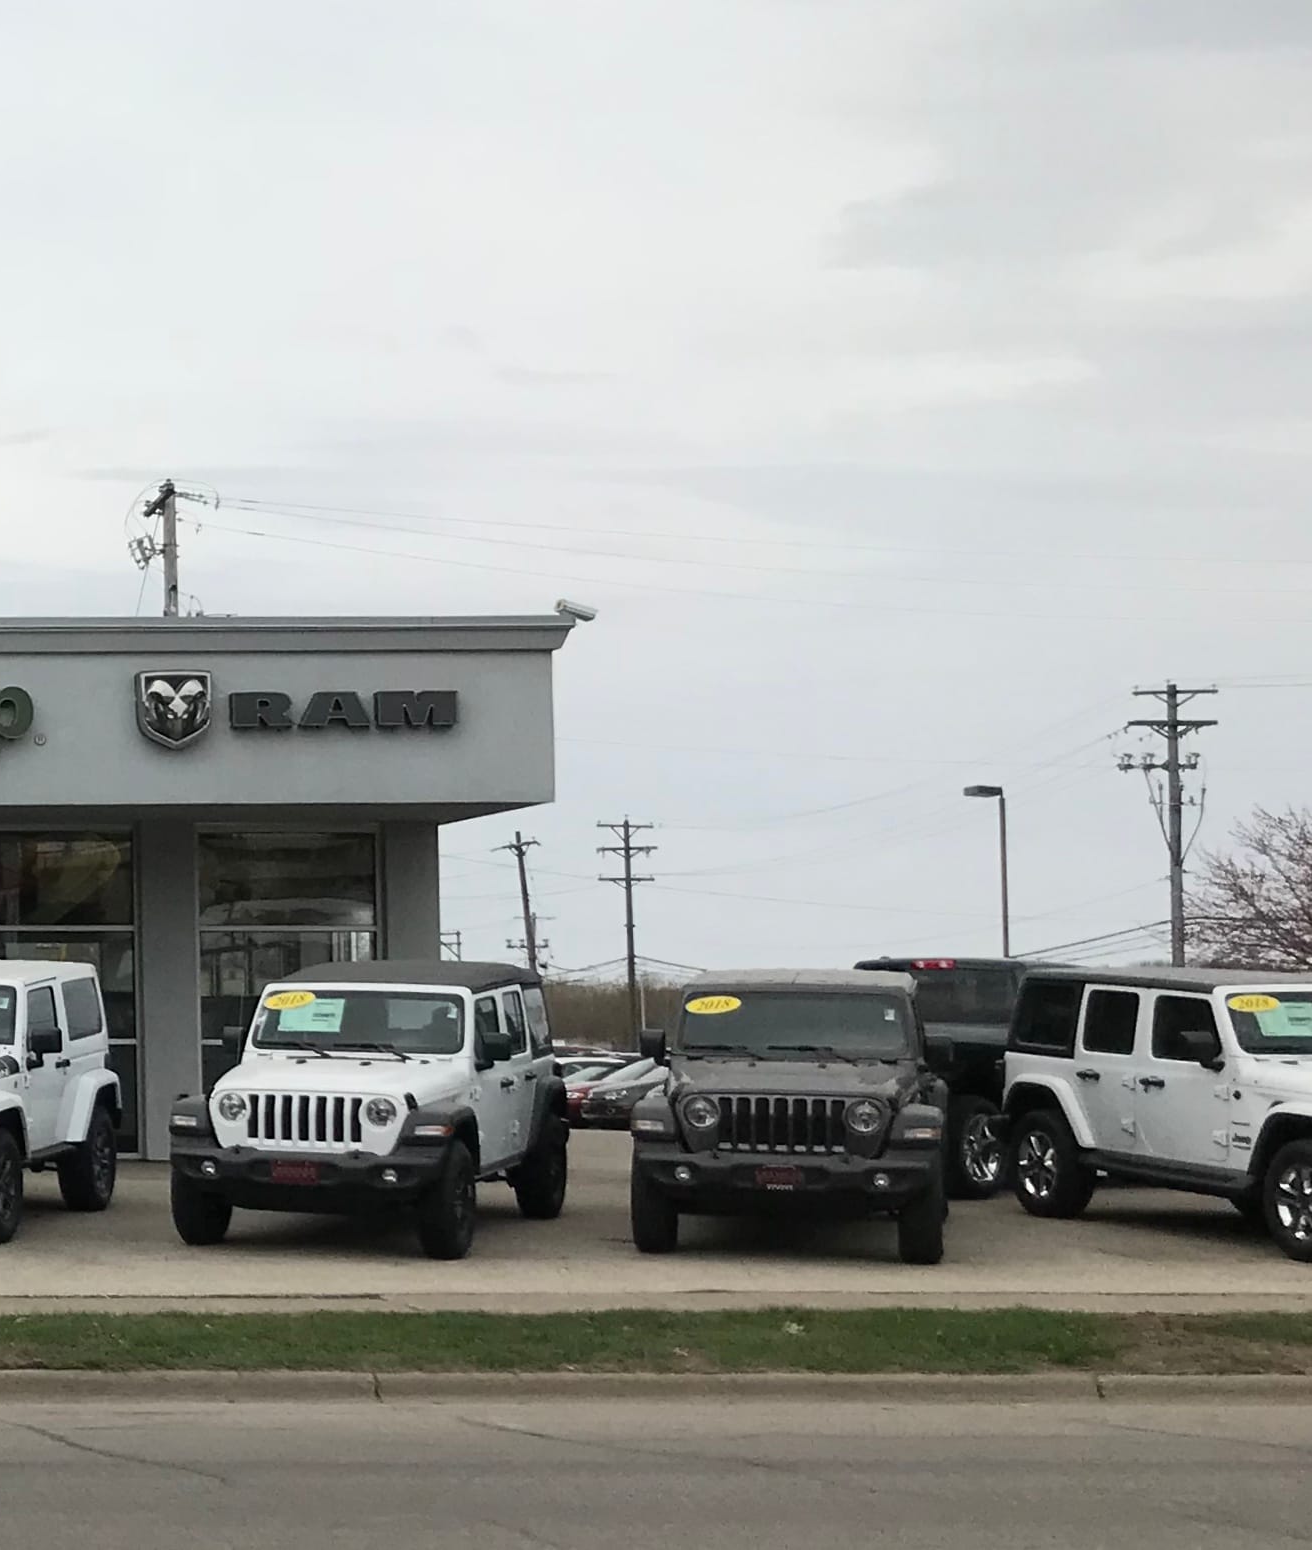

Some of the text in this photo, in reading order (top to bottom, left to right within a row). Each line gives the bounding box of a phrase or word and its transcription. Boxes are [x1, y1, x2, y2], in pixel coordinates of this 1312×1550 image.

[229, 690, 459, 729] RAM
[273, 992, 310, 1006] 2018
[697, 999, 732, 1010] 2018
[1238, 998, 1269, 1009] 2018
